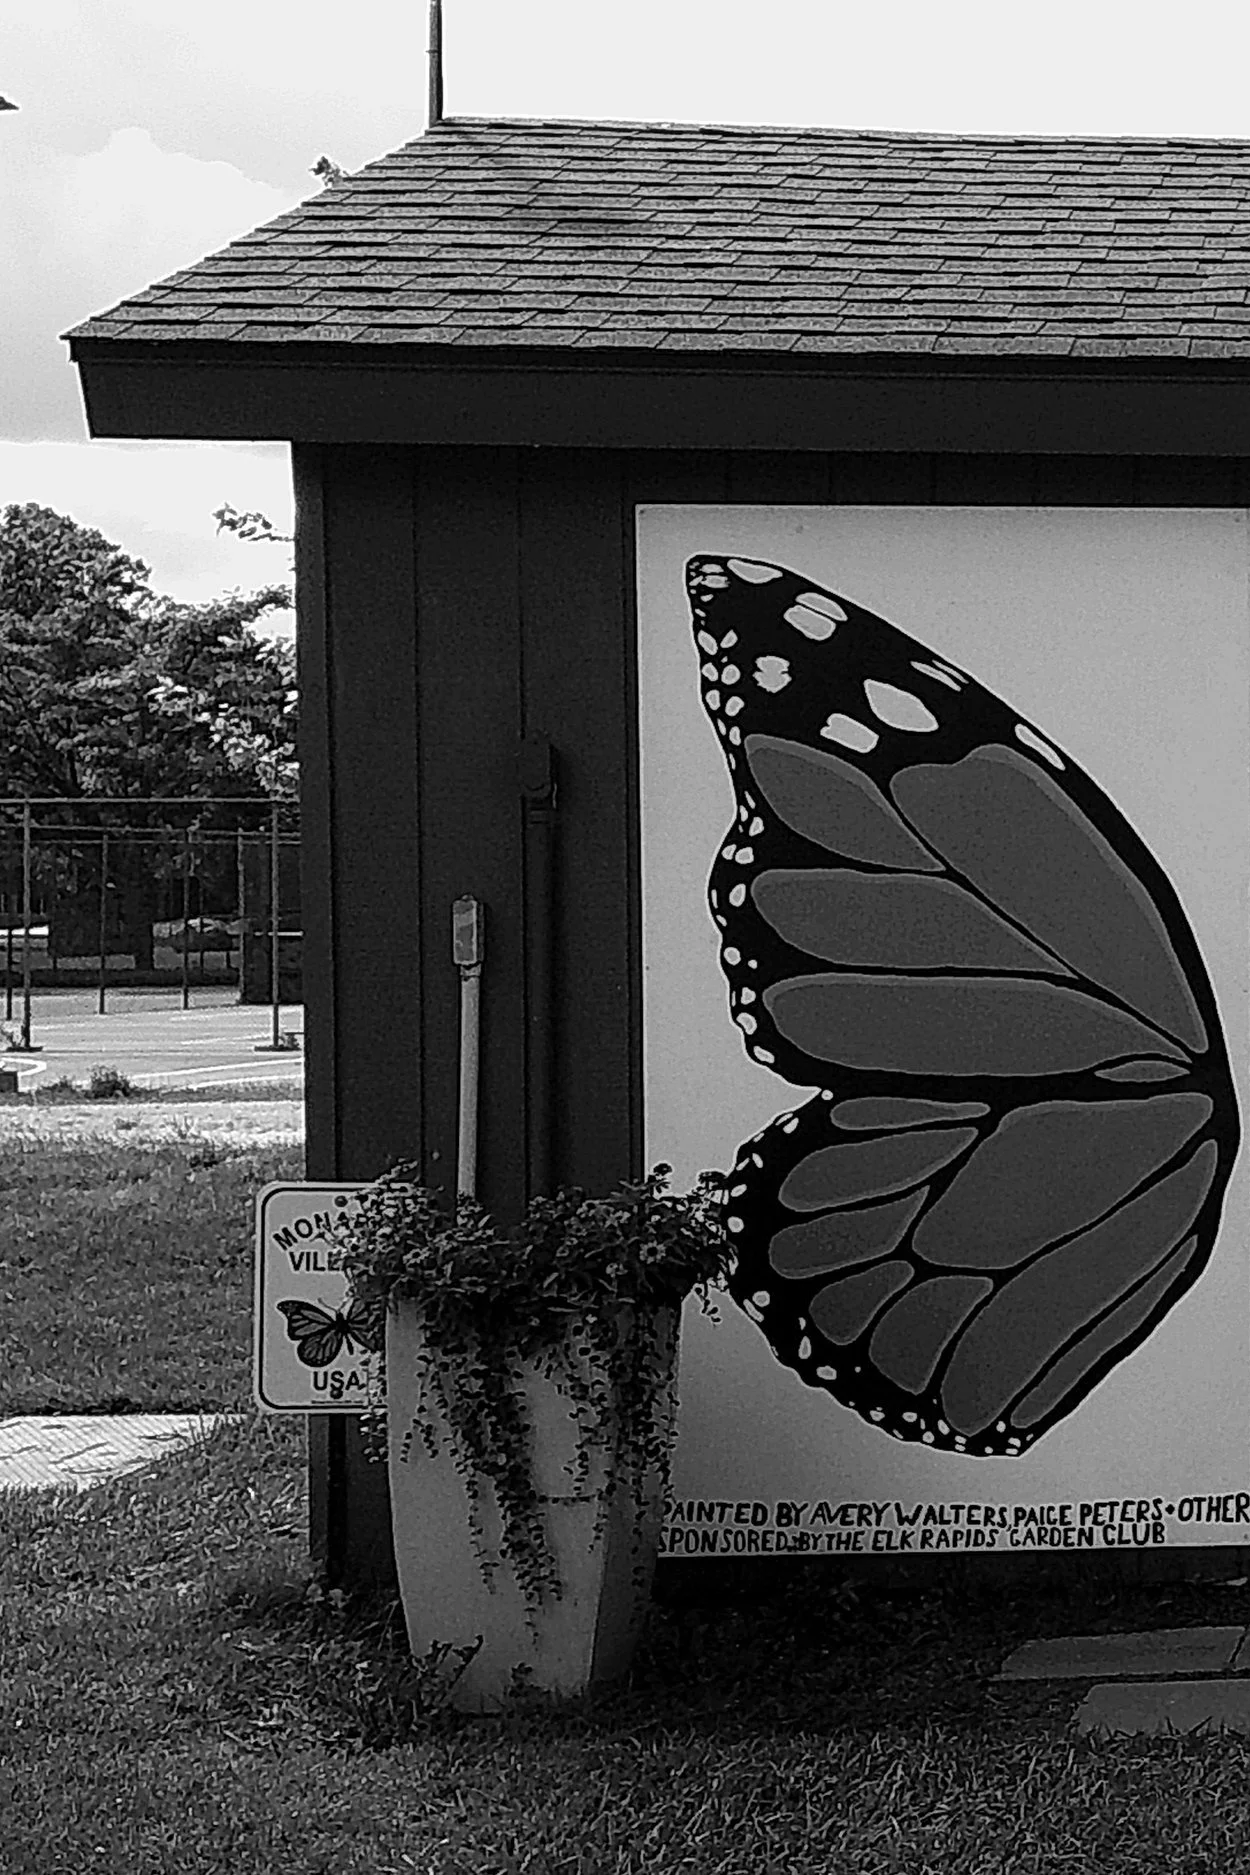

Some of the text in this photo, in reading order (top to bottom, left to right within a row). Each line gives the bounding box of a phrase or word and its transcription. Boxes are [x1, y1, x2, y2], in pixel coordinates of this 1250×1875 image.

[273, 1211, 352, 1251] MONA
[313, 1370, 360, 1391] USA
[776, 1502, 809, 1527] BY
[809, 1501, 891, 1527] AVERY
[1013, 1504, 1073, 1527] PAIGE
[1079, 1498, 1163, 1526] PETERS
[1177, 1492, 1250, 1523] OTHER
[658, 1521, 1166, 1553] SPONSORED BY THE ELK RAPIDS GARDEN CLUB
